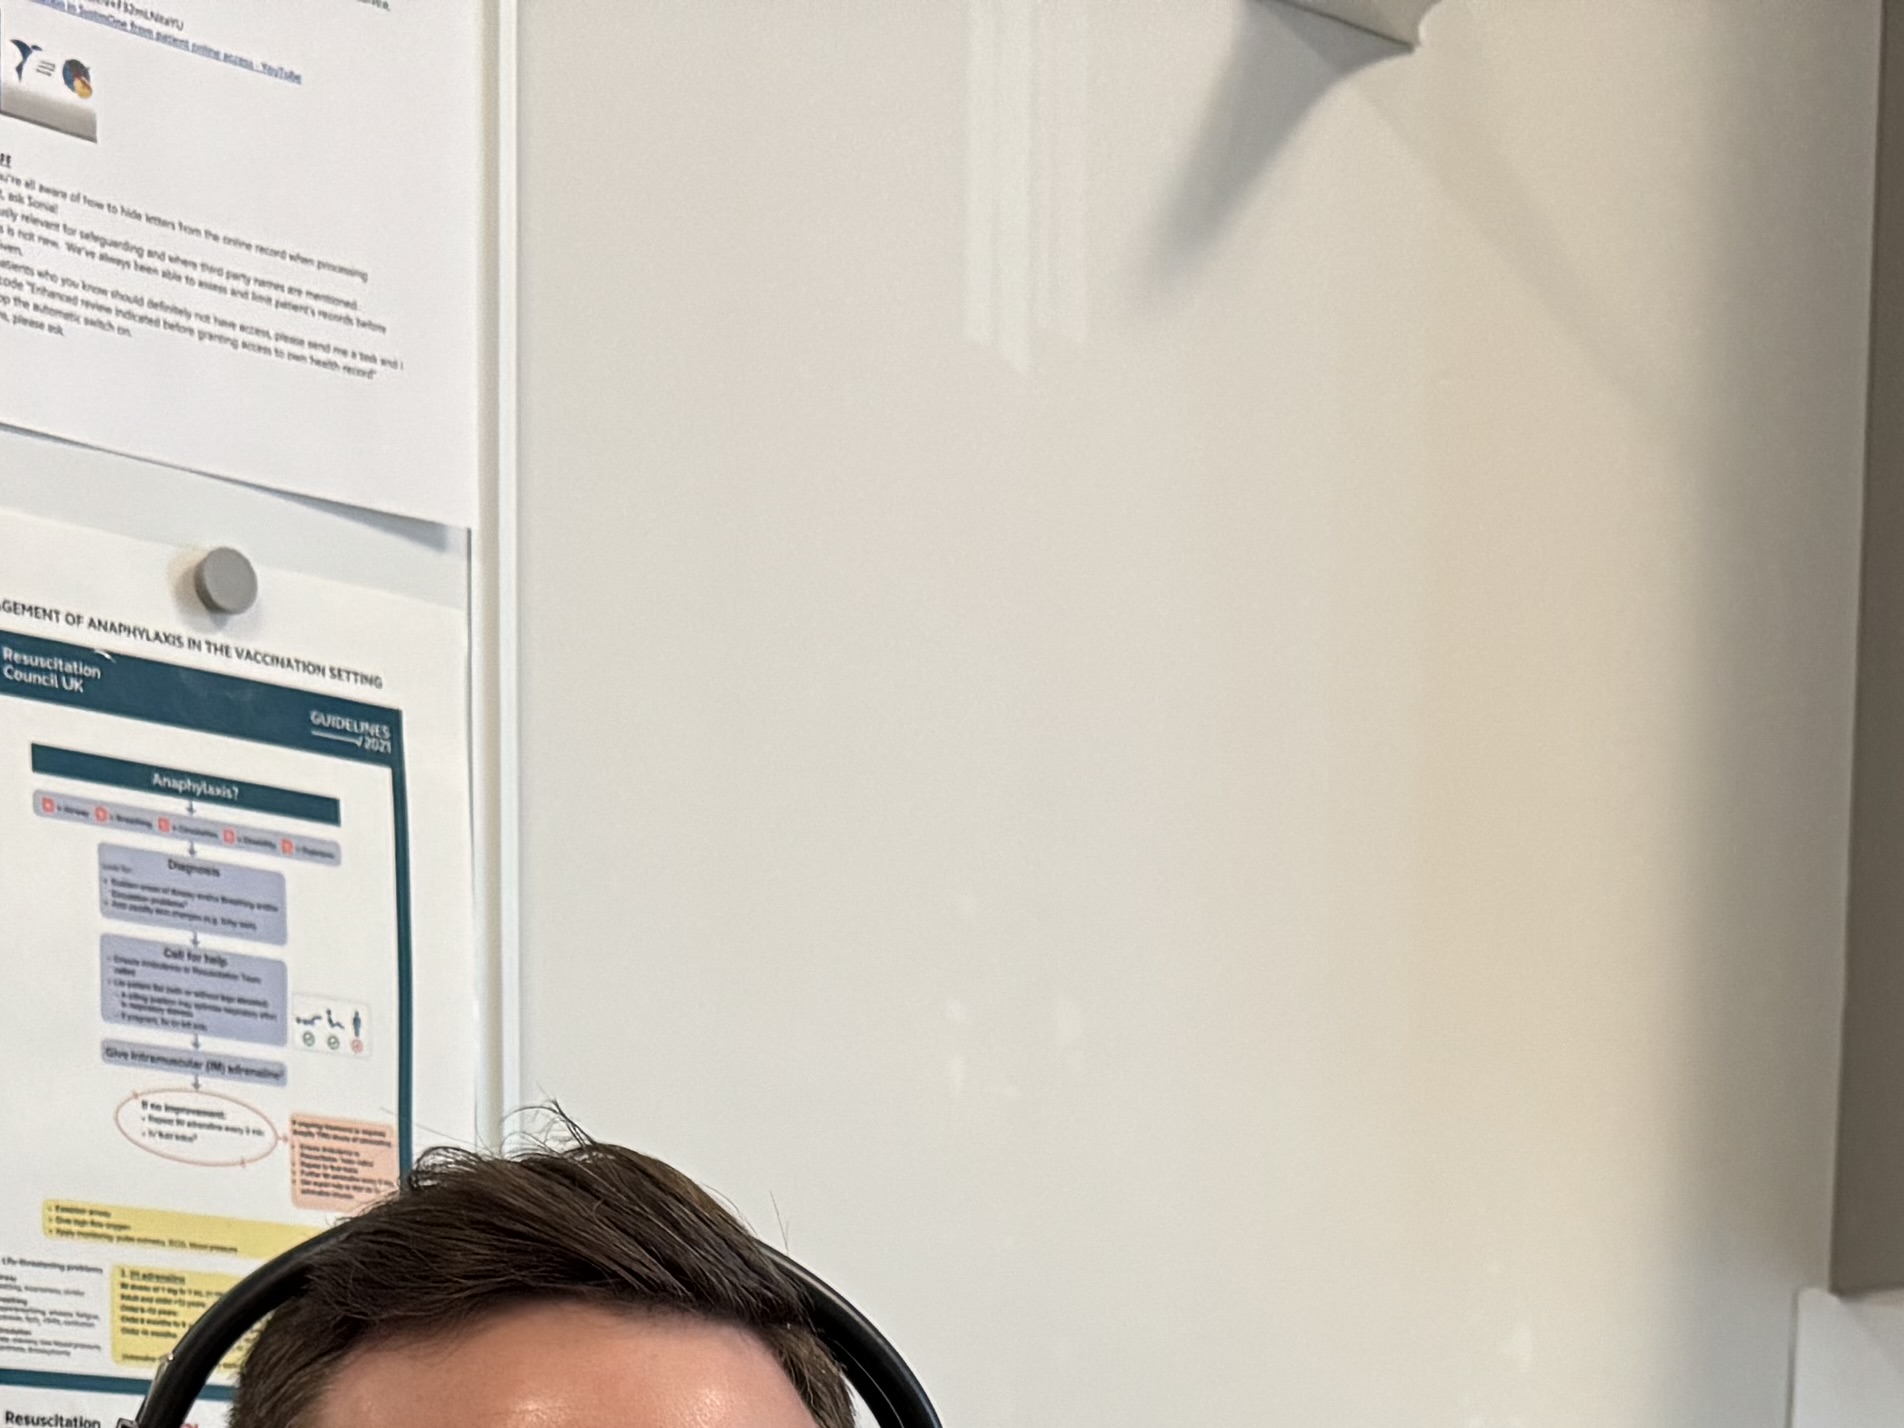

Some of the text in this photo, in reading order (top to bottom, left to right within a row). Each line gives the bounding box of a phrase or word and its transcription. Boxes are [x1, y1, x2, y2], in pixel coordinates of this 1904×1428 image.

[2, 646, 100, 679] Resuscitation
[64, 612, 83, 626] OF
[88, 617, 184, 648] ANAPHYLAXIS
[187, 637, 201, 651] IN
[204, 639, 230, 658] THE
[235, 647, 325, 677] VACCINATION
[329, 666, 382, 688] SETTING
[3, 664, 83, 692] Council UK
[152, 773, 238, 799] Anaphylaxis?
